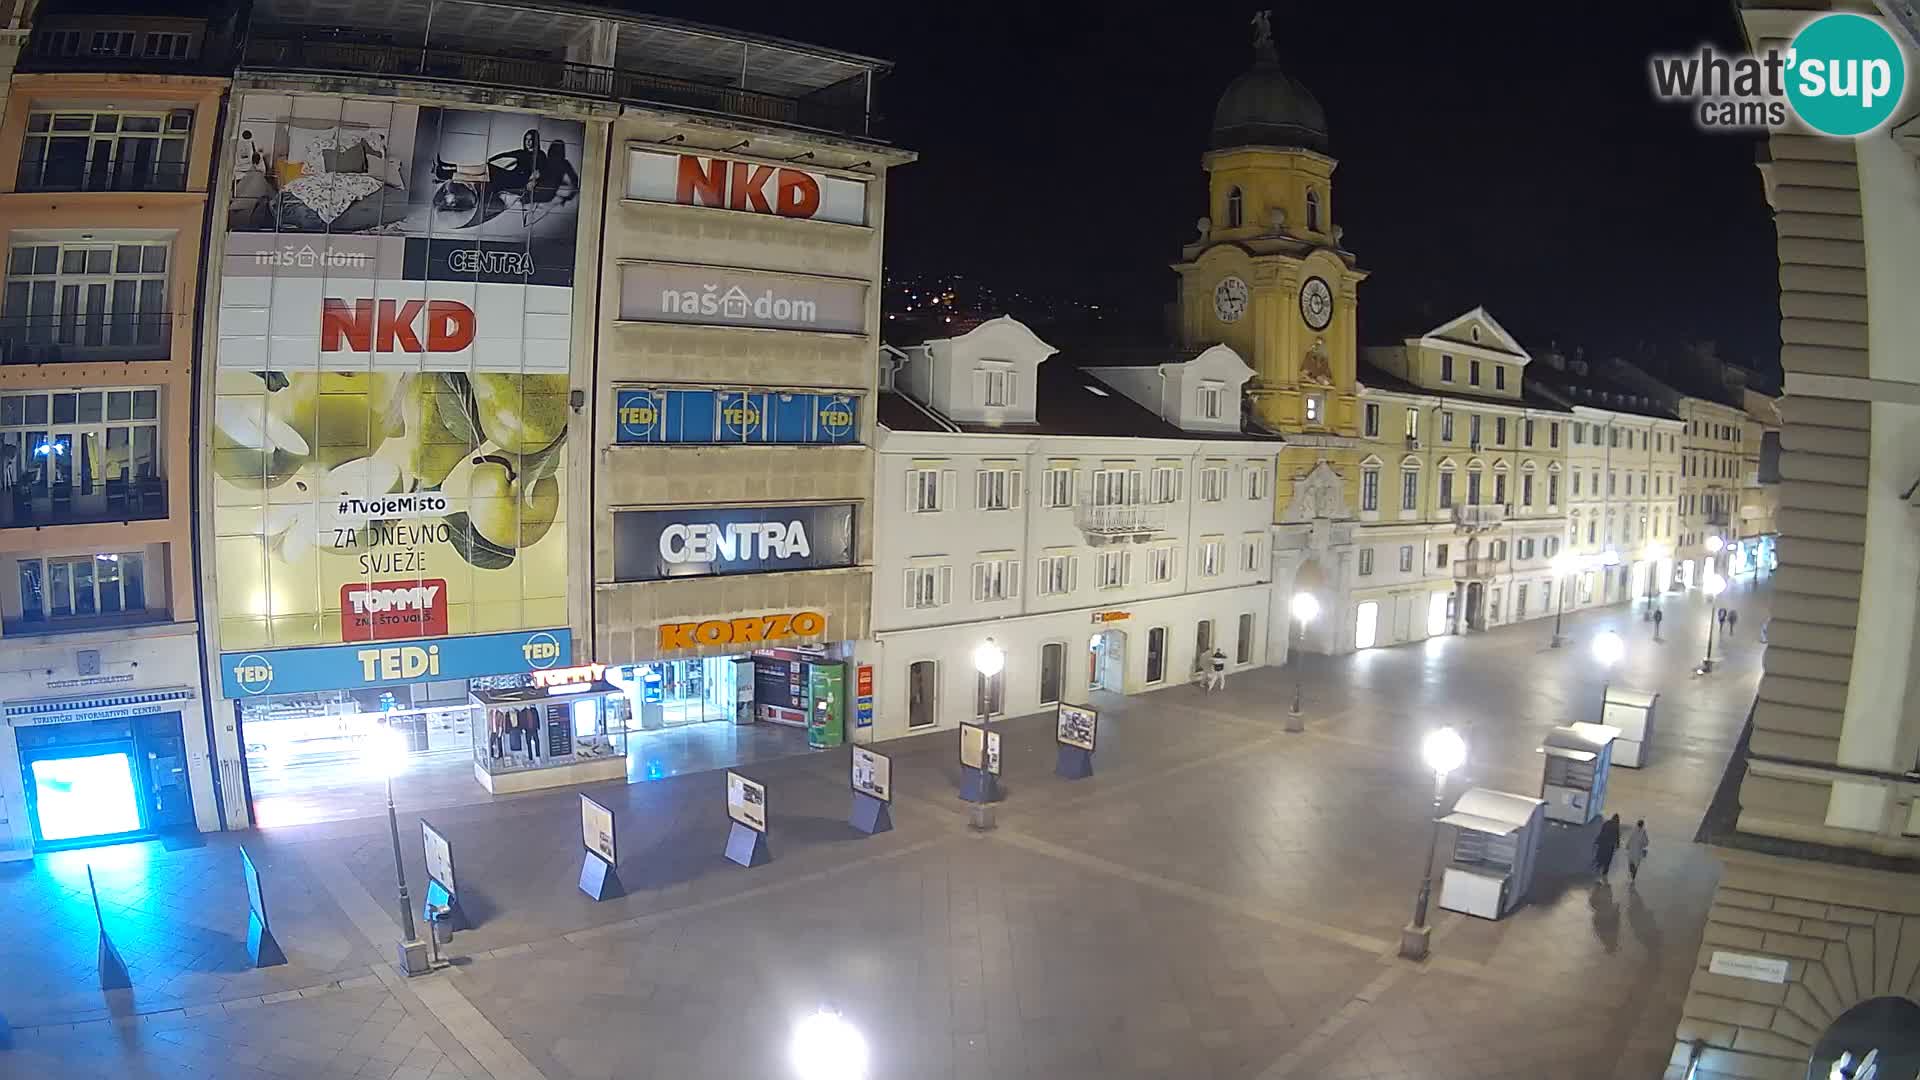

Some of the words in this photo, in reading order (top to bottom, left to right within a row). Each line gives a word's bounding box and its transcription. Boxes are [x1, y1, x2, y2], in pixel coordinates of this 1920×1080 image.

[677, 154, 821, 219] NKD
[255, 246, 295, 267] naš
[320, 247, 366, 268] dom
[448, 249, 535, 275] CENTRA
[661, 283, 718, 316] naš
[754, 289, 817, 322] dom
[320, 297, 477, 353] NKD
[619, 407, 658, 425] TEDi
[723, 409, 760, 425] TEDi
[819, 410, 854, 426] TEDi
[338, 496, 447, 516] #TvojeMisto
[333, 528, 358, 549] ZA
[367, 523, 451, 547] DNEVNO
[659, 520, 811, 564] CENTRA
[359, 546, 426, 575] SVJEŽE
[348, 585, 440, 614] TOMMY
[379, 613, 401, 625] ŠTO
[659, 611, 826, 652] KORZO
[357, 644, 440, 682] TEDi
[522, 641, 561, 660] TEDi
[233, 665, 274, 683] TEDi
[531, 662, 608, 690] TOMMY
[132, 705, 162, 715] CENTAR
